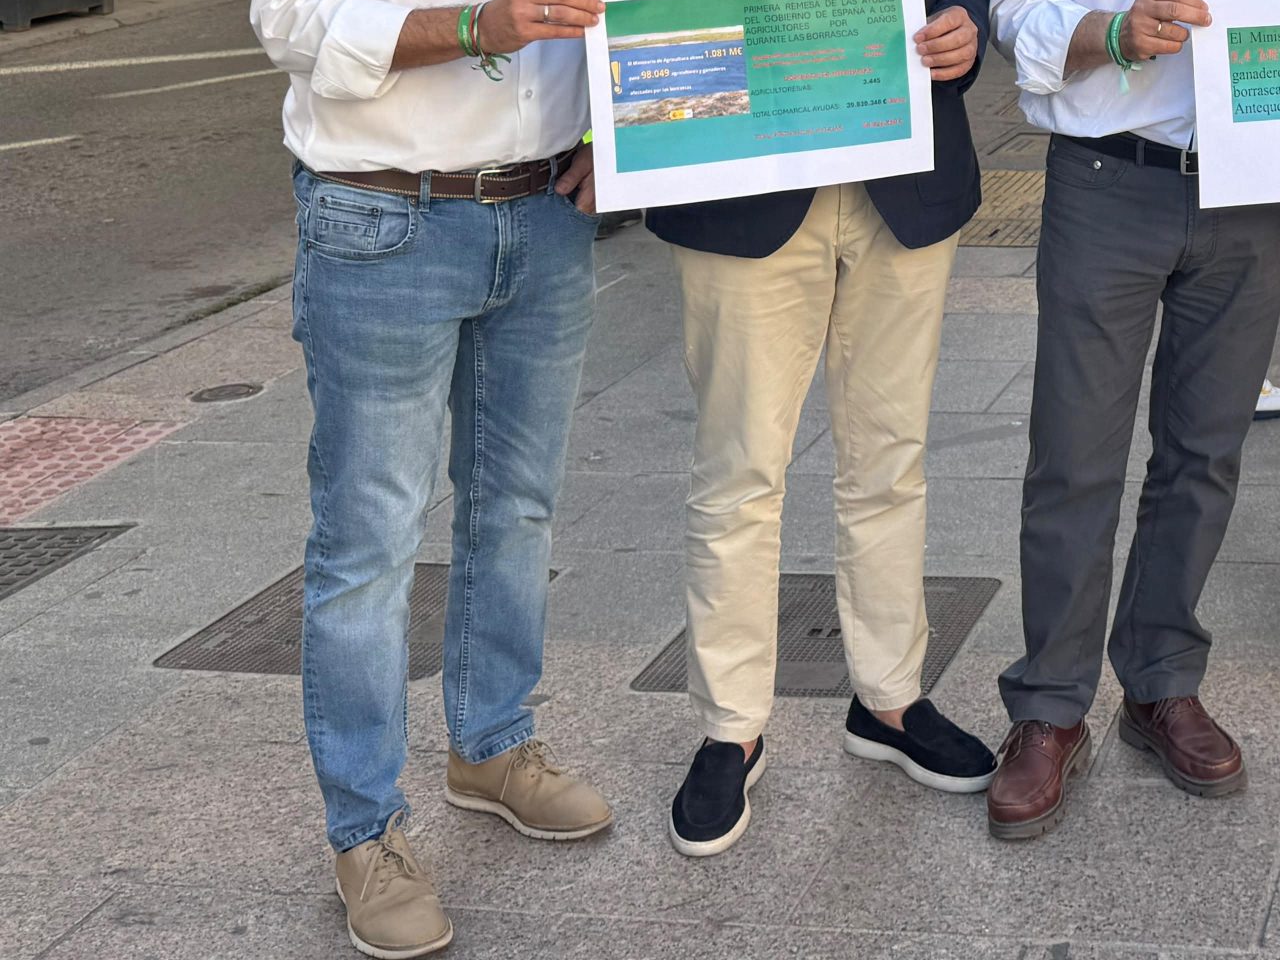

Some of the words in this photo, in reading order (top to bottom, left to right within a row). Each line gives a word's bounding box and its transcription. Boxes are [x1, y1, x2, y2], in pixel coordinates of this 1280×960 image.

[744, 4, 780, 13] PRIMERA
[785, 0, 820, 10] REMESA
[826, 0, 837, 7] DE
[745, 17, 760, 25] DEL
[765, 12, 811, 23] GOBIERNO
[832, 7, 865, 17] ESPAÑA
[880, 5, 896, 13] LOS
[746, 23, 809, 34] AGRICULTORES
[830, 19, 847, 27] POR
[867, 15, 897, 24] DAÑOS
[747, 36, 786, 46] DURANTE
[789, 34, 804, 42] LAS
[807, 29, 859, 40] BORRASCAS
[1230, 32, 1242, 44] El
[704, 49, 727, 58] 1.081
[729, 47, 742, 56] M€
[641, 68, 670, 79] 98.049
[753, 110, 772, 118] TOTAL
